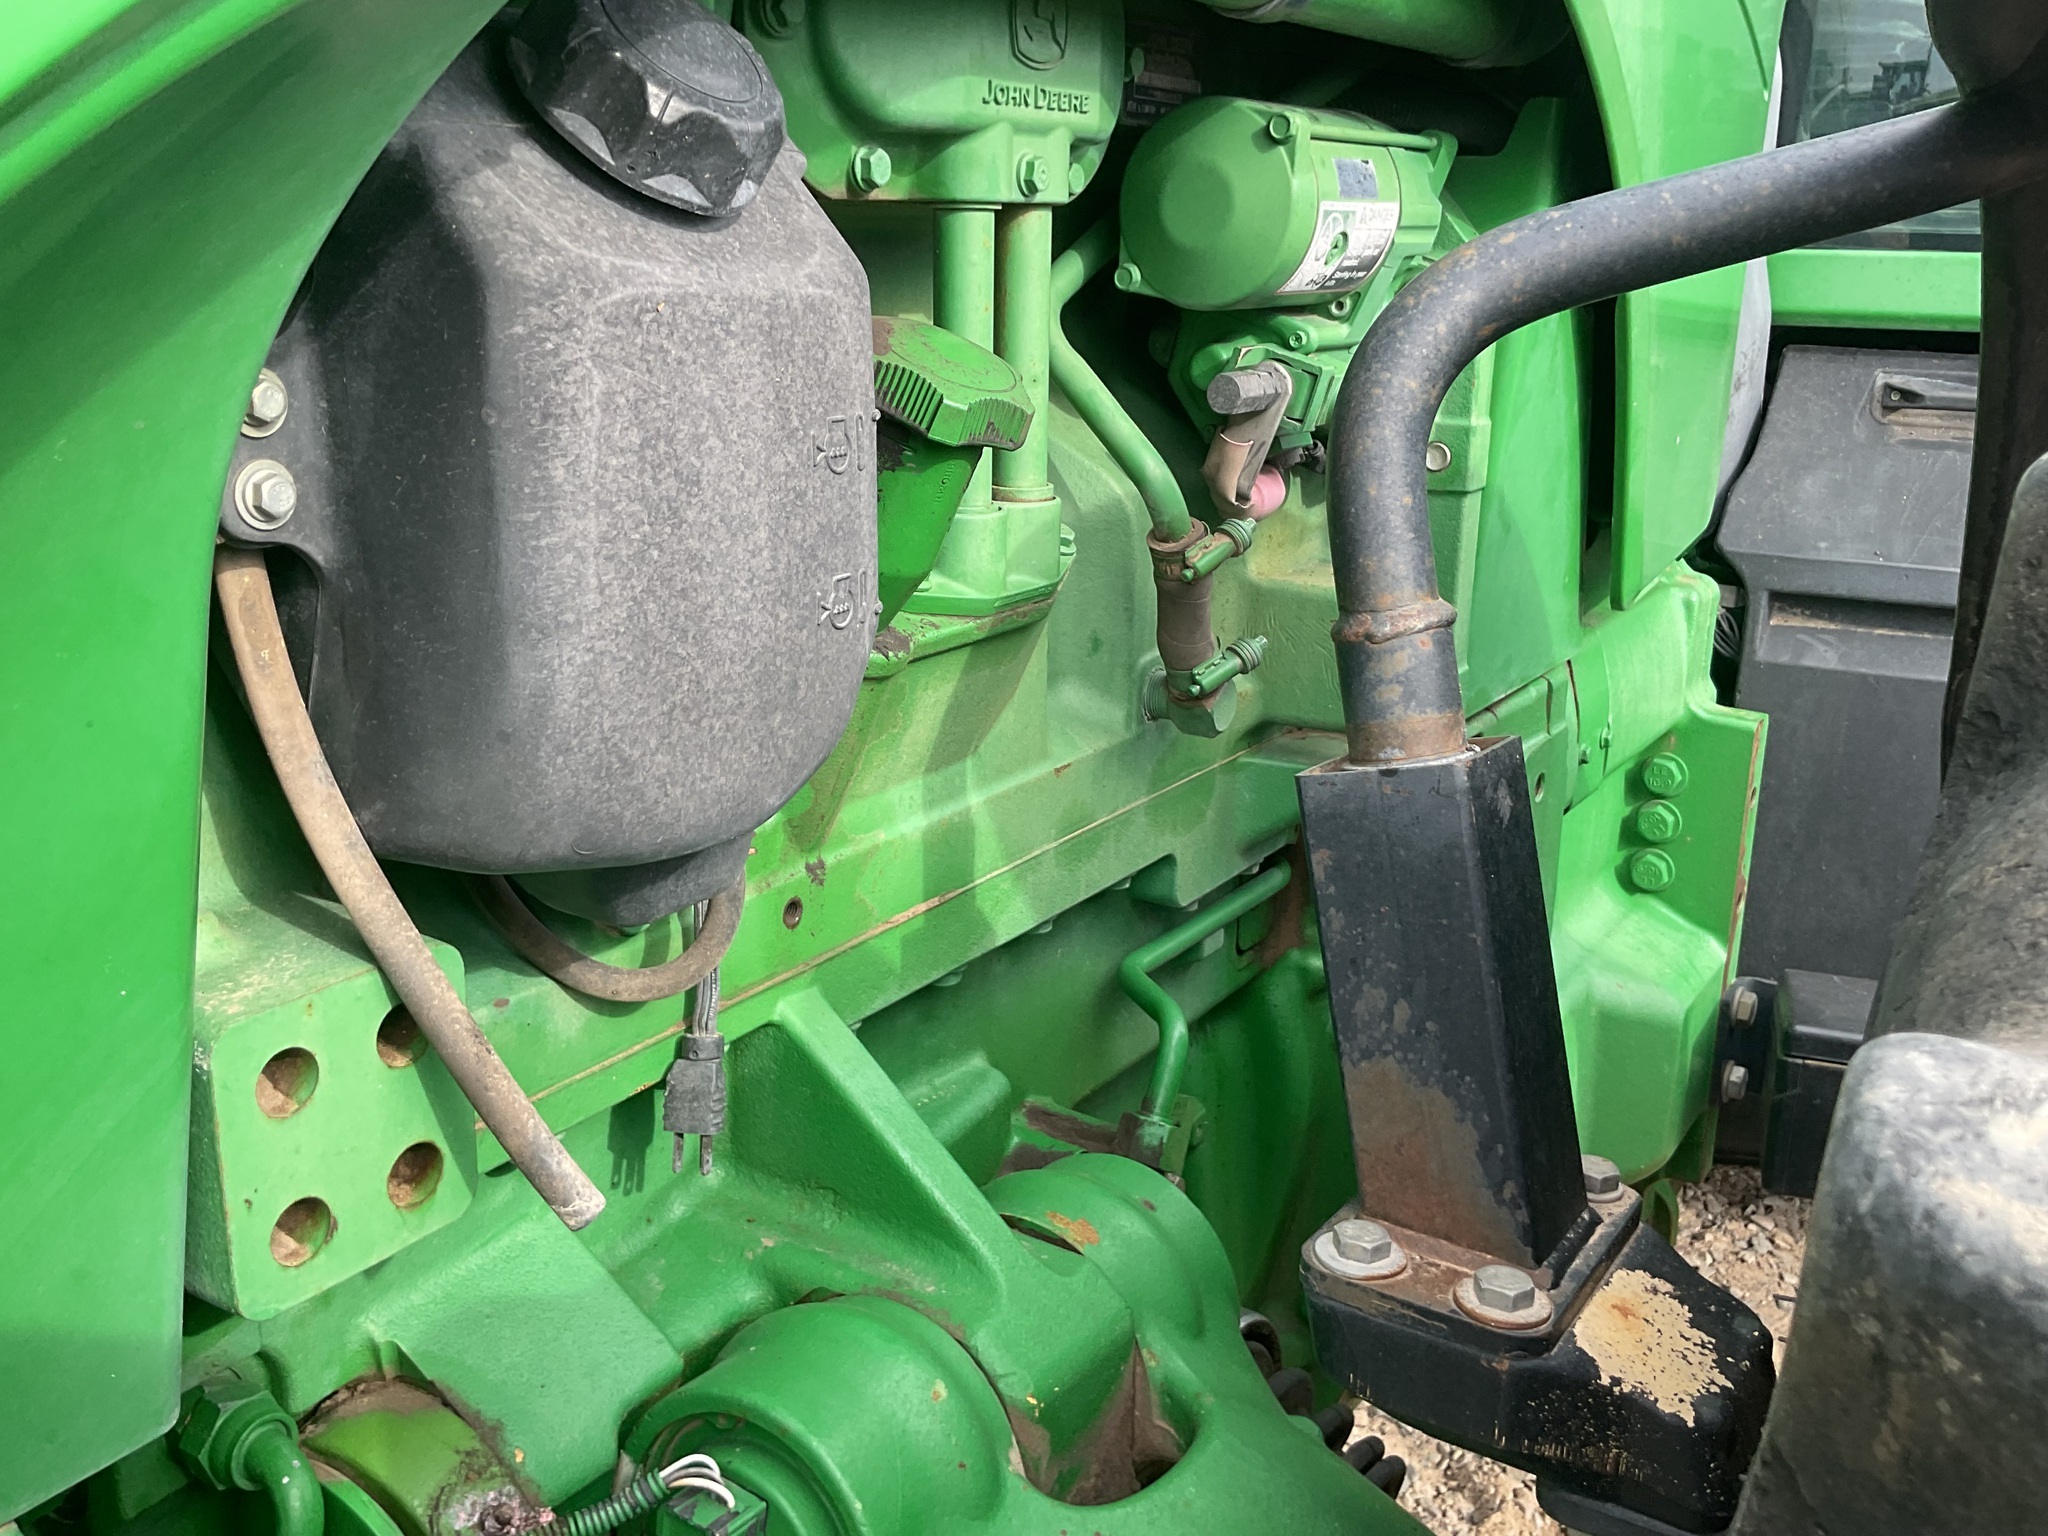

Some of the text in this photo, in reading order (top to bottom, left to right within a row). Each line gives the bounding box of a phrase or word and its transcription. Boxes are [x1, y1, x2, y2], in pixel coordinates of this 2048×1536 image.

[981, 79, 1090, 114] JOHN DEERE
[1648, 777, 1672, 788] 10.9
